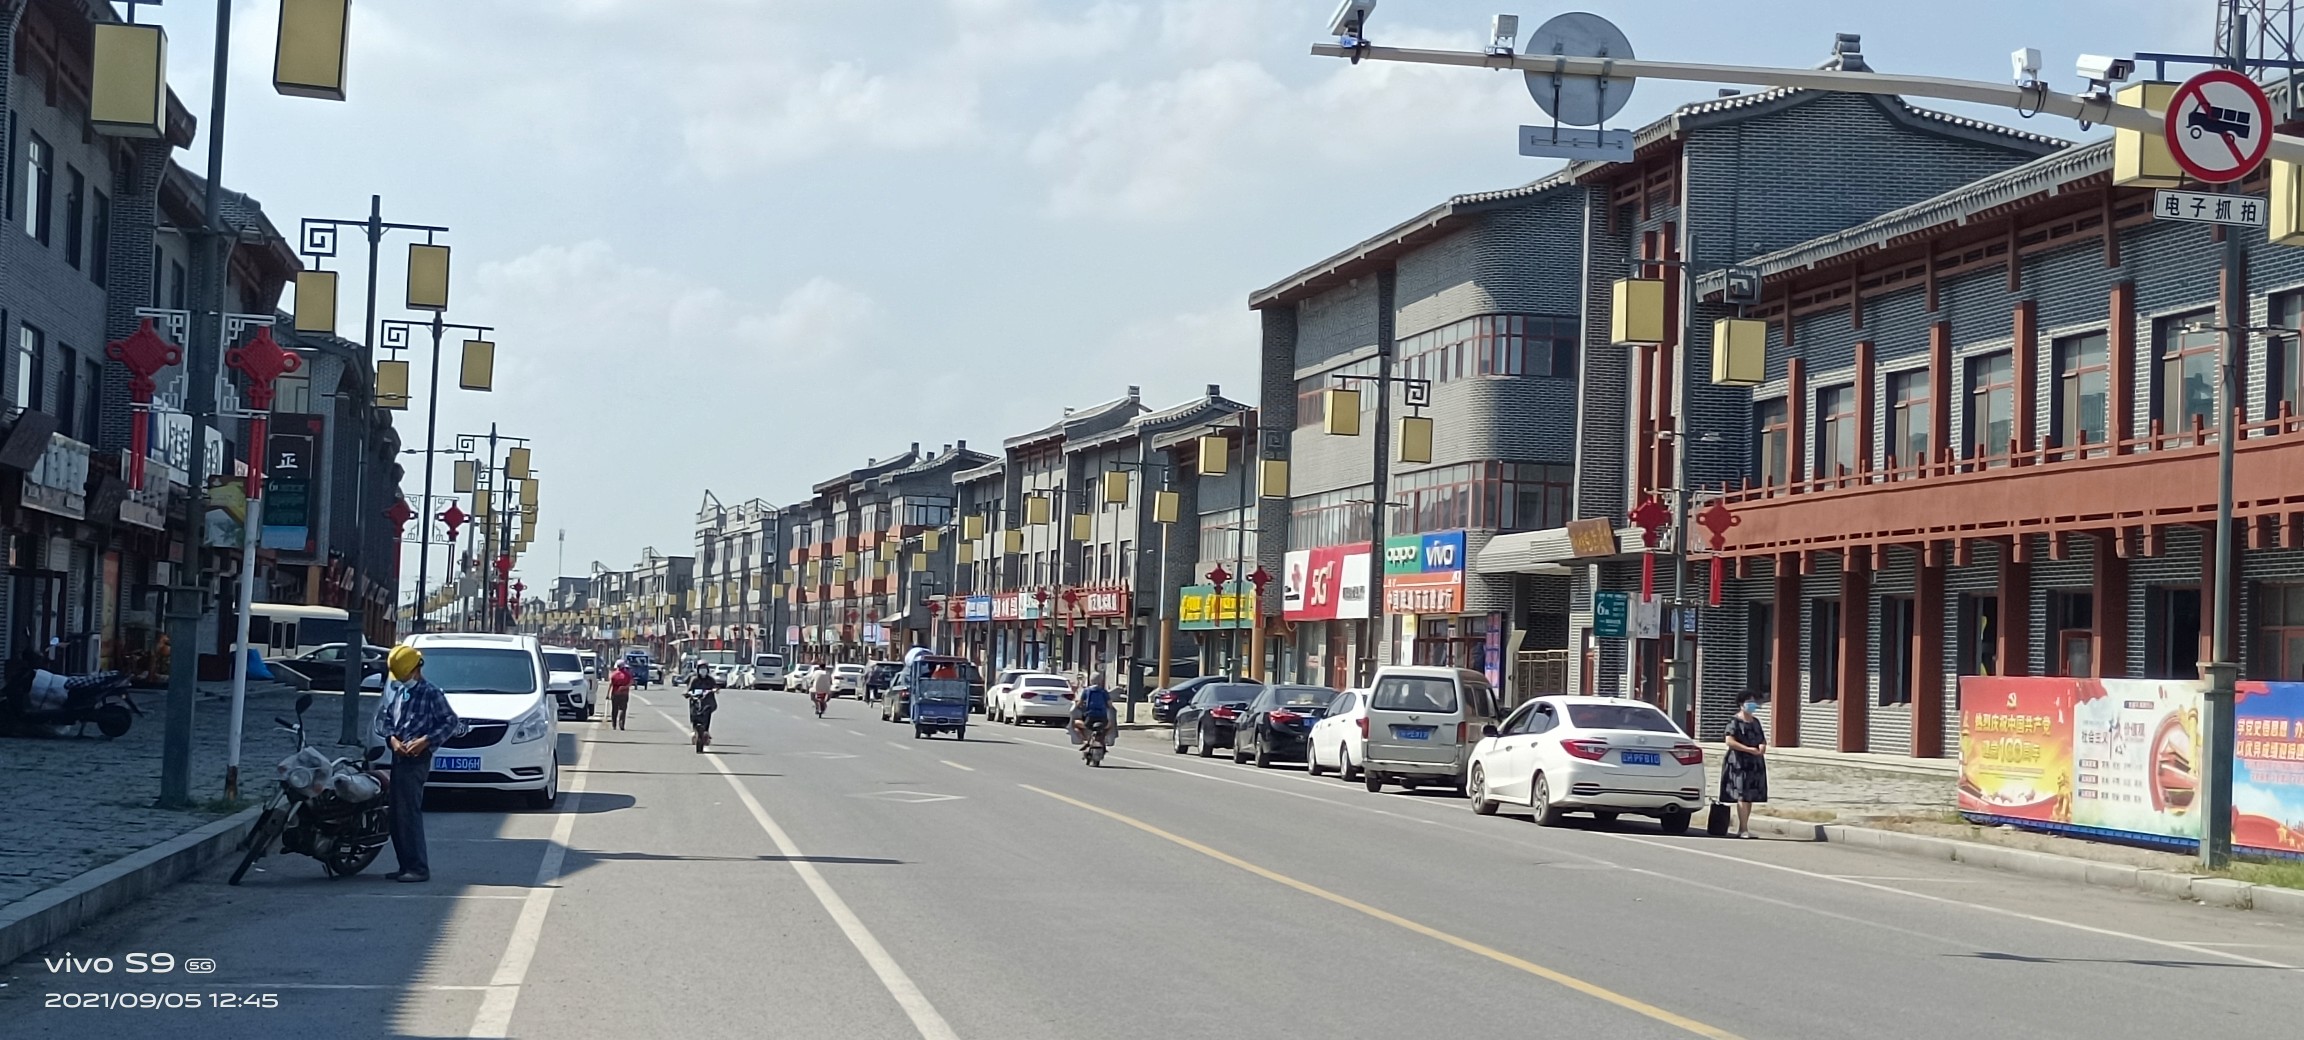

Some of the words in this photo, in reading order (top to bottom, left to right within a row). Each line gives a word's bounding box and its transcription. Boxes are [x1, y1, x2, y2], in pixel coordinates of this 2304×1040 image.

[2165, 194, 2257, 222] 电子抓拍
[275, 452, 298, 469] 正
[1426, 540, 1455, 567] vivo
[1974, 712, 2051, 736] 热烈庆祝中国共产党
